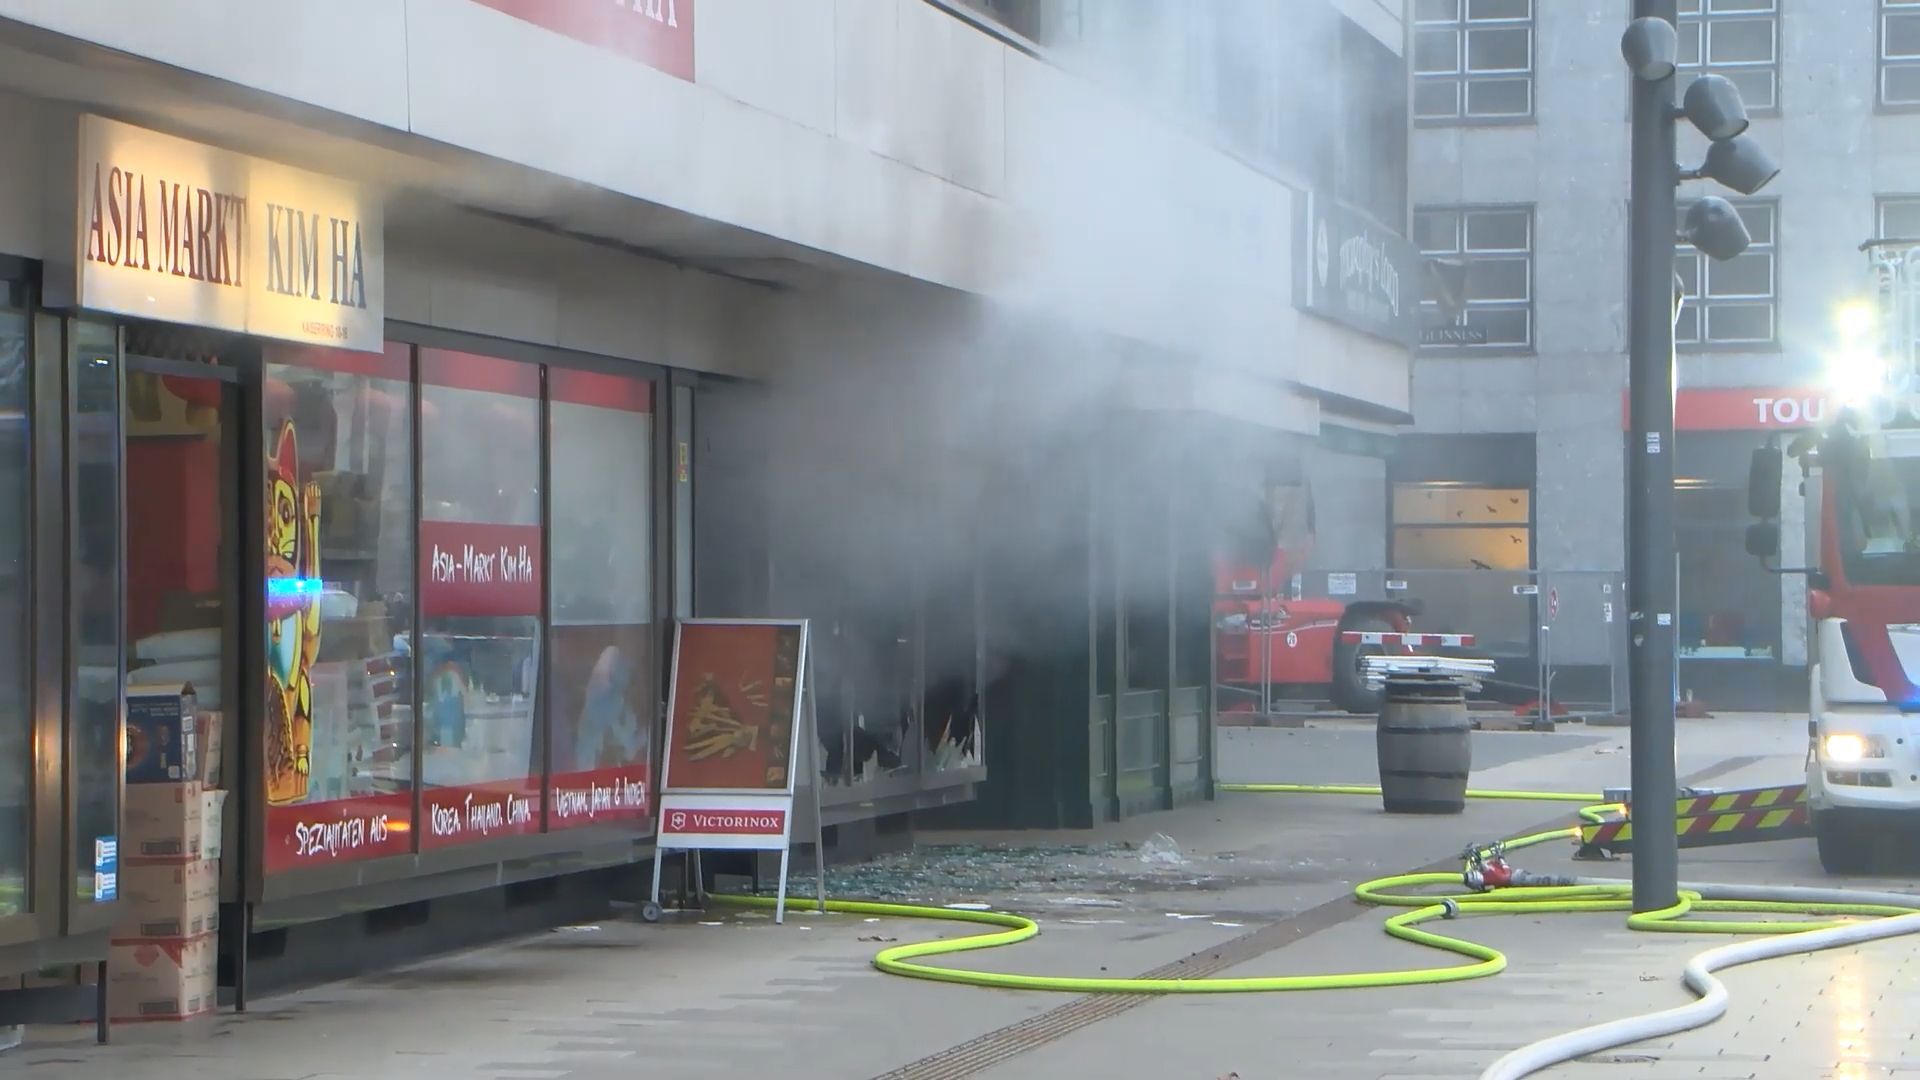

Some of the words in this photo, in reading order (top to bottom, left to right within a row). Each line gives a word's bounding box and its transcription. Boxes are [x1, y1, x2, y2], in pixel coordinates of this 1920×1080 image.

[87, 162, 150, 270] ASIA
[157, 179, 247, 288] MARKT
[266, 202, 321, 301] KIM
[329, 217, 367, 310] HA
[693, 814, 779, 829] VICTORINOX
